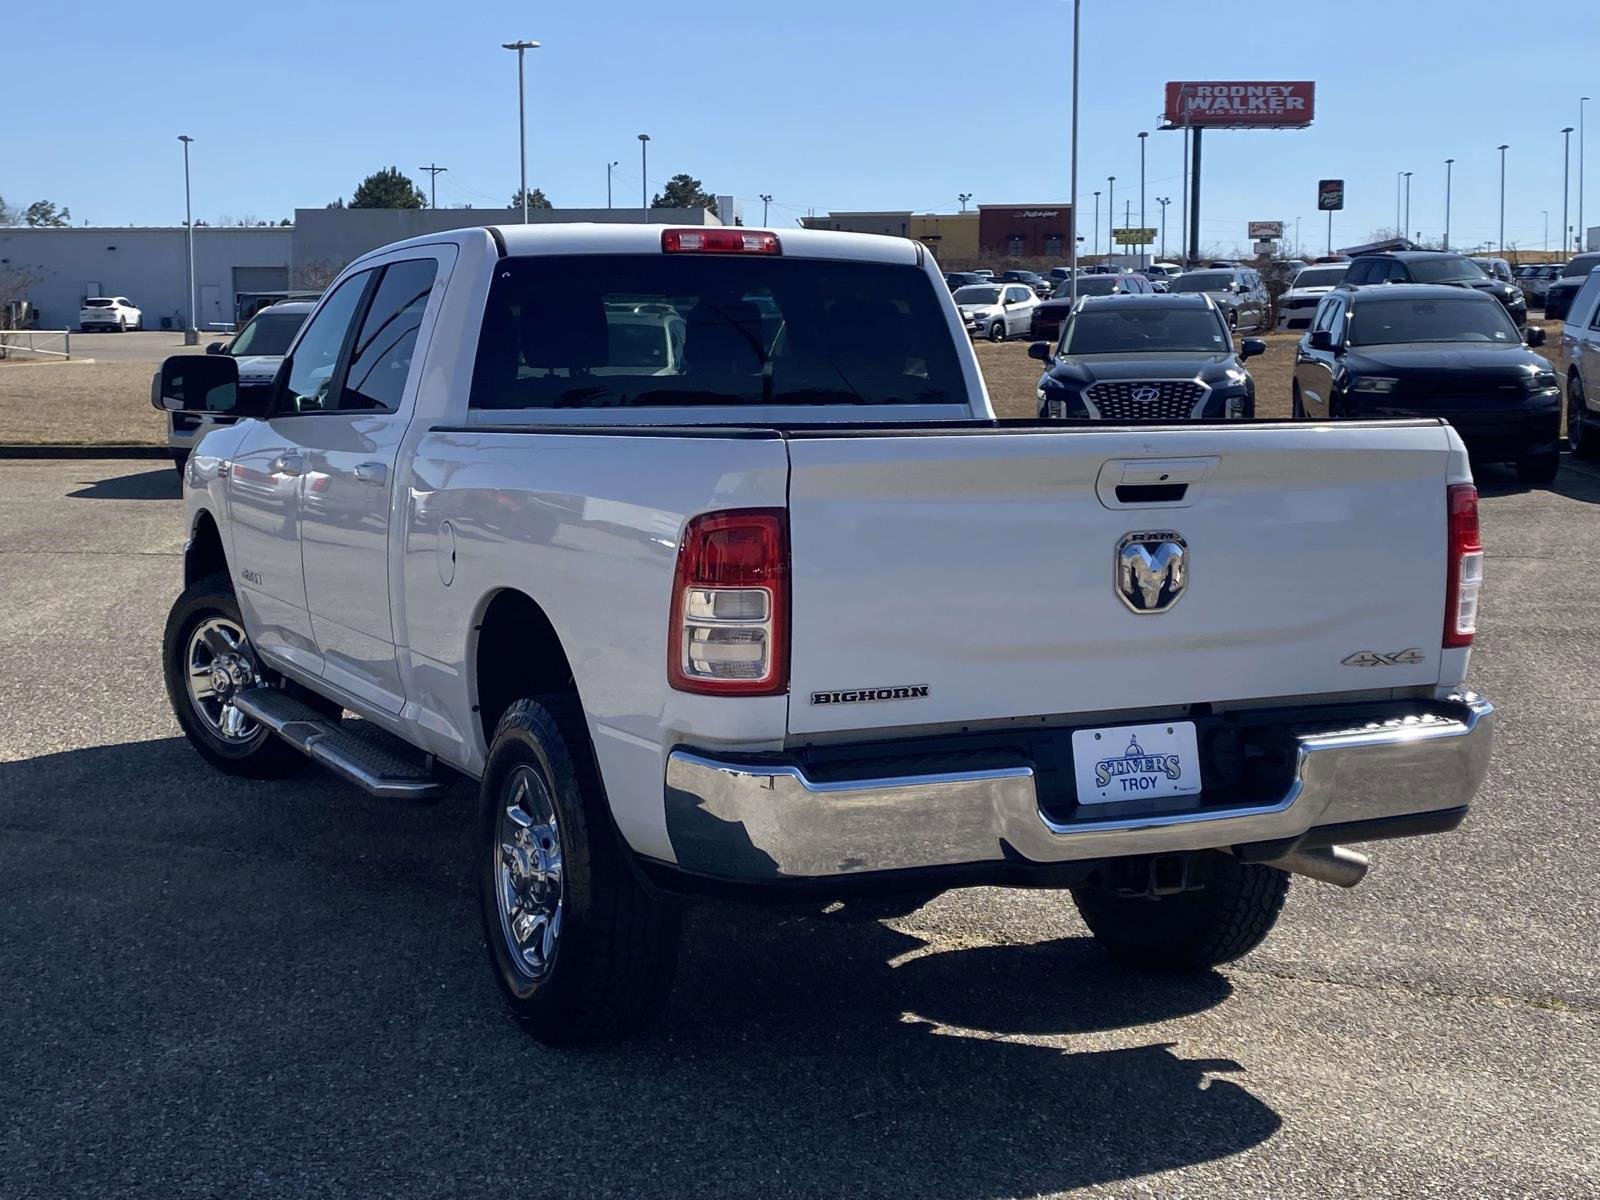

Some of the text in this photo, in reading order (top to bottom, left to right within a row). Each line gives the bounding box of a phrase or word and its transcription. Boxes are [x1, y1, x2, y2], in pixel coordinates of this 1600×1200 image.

[1197, 86, 1294, 96] RODNEY
[1188, 97, 1304, 109] WALKER
[1131, 532, 1176, 541] RAM
[1095, 755, 1181, 788] STIVERS
[1120, 776, 1158, 792] TROY
